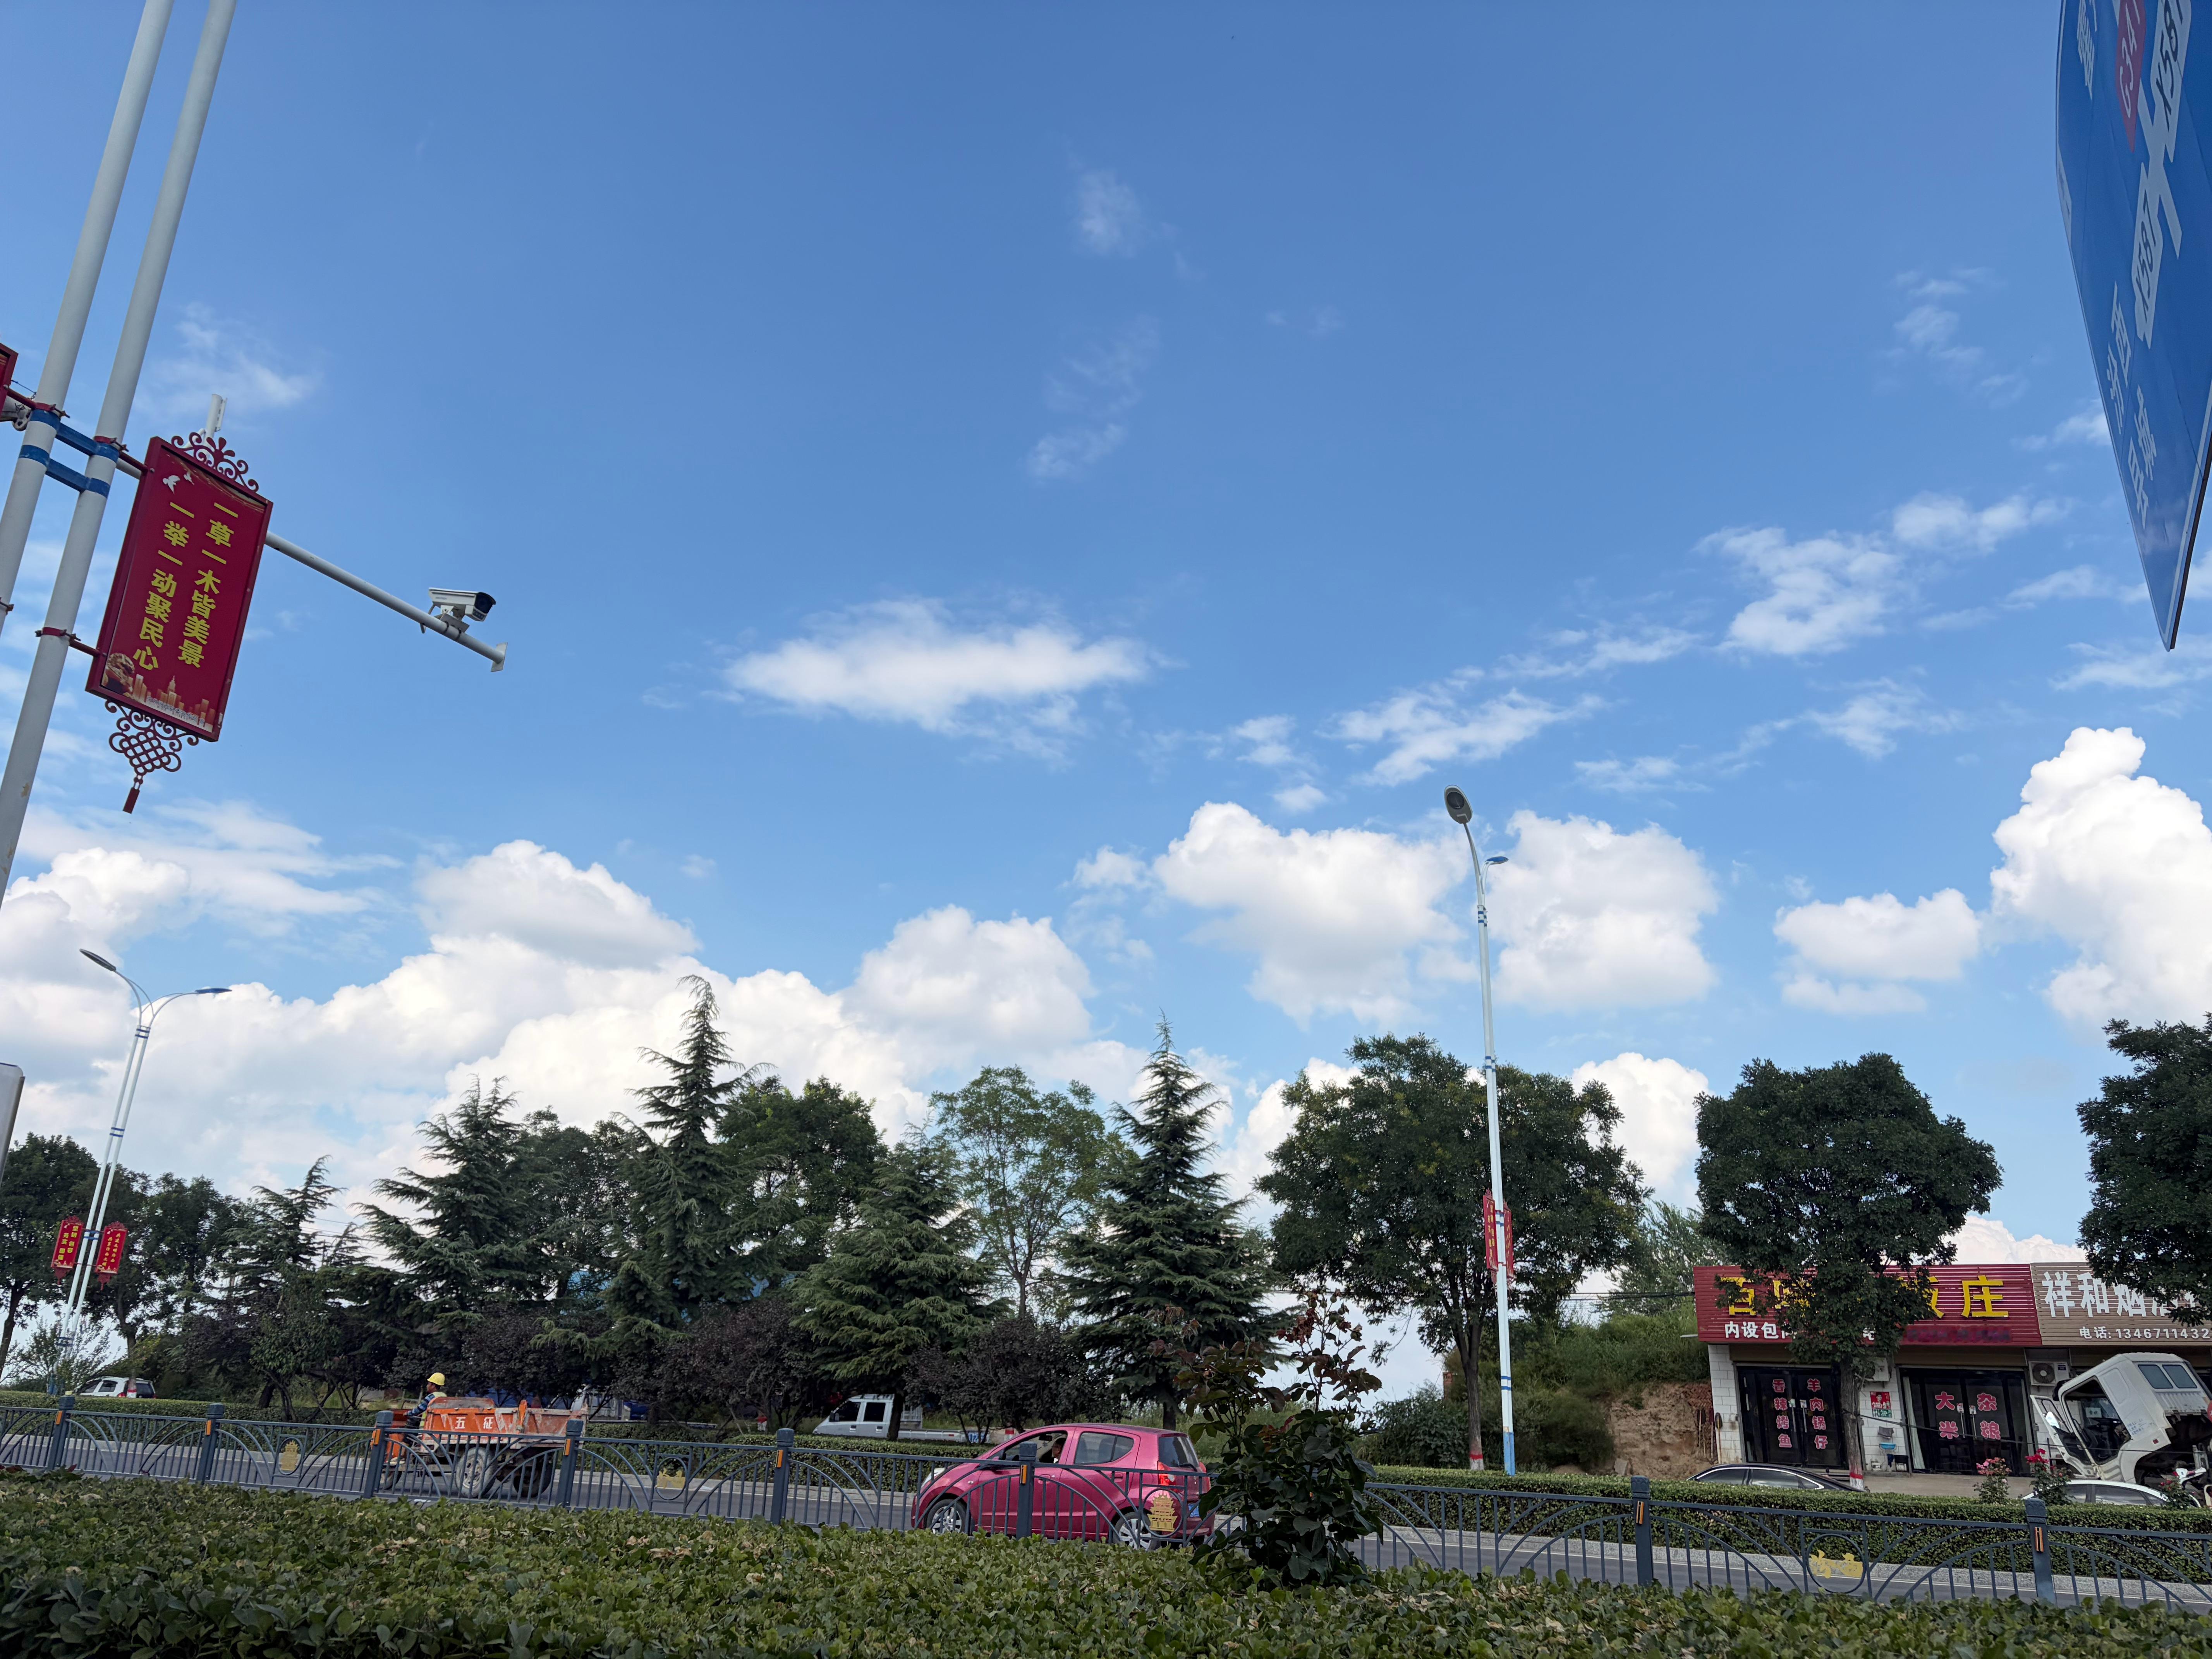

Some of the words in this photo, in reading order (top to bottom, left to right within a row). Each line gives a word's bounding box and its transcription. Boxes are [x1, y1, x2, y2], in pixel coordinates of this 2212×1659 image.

[2076, 0, 2097, 100] 霍
[2135, 190, 2156, 323] X587
[2107, 281, 2132, 435] 汾西
[2128, 384, 2157, 529] 县城
[133, 501, 195, 671] 一举一动聚民心
[178, 502, 239, 669] 一草一木皆美景
[2042, 1271, 2203, 1318] 祥和烟
[455, 1417, 494, 1429] 五征
[1772, 1379, 1792, 1448] 香辣烤鱼
[1807, 1378, 1828, 1449] 羊肉锅仔
[1935, 1391, 1959, 1439] 大米
[1977, 1392, 2001, 1440] 杂粮
